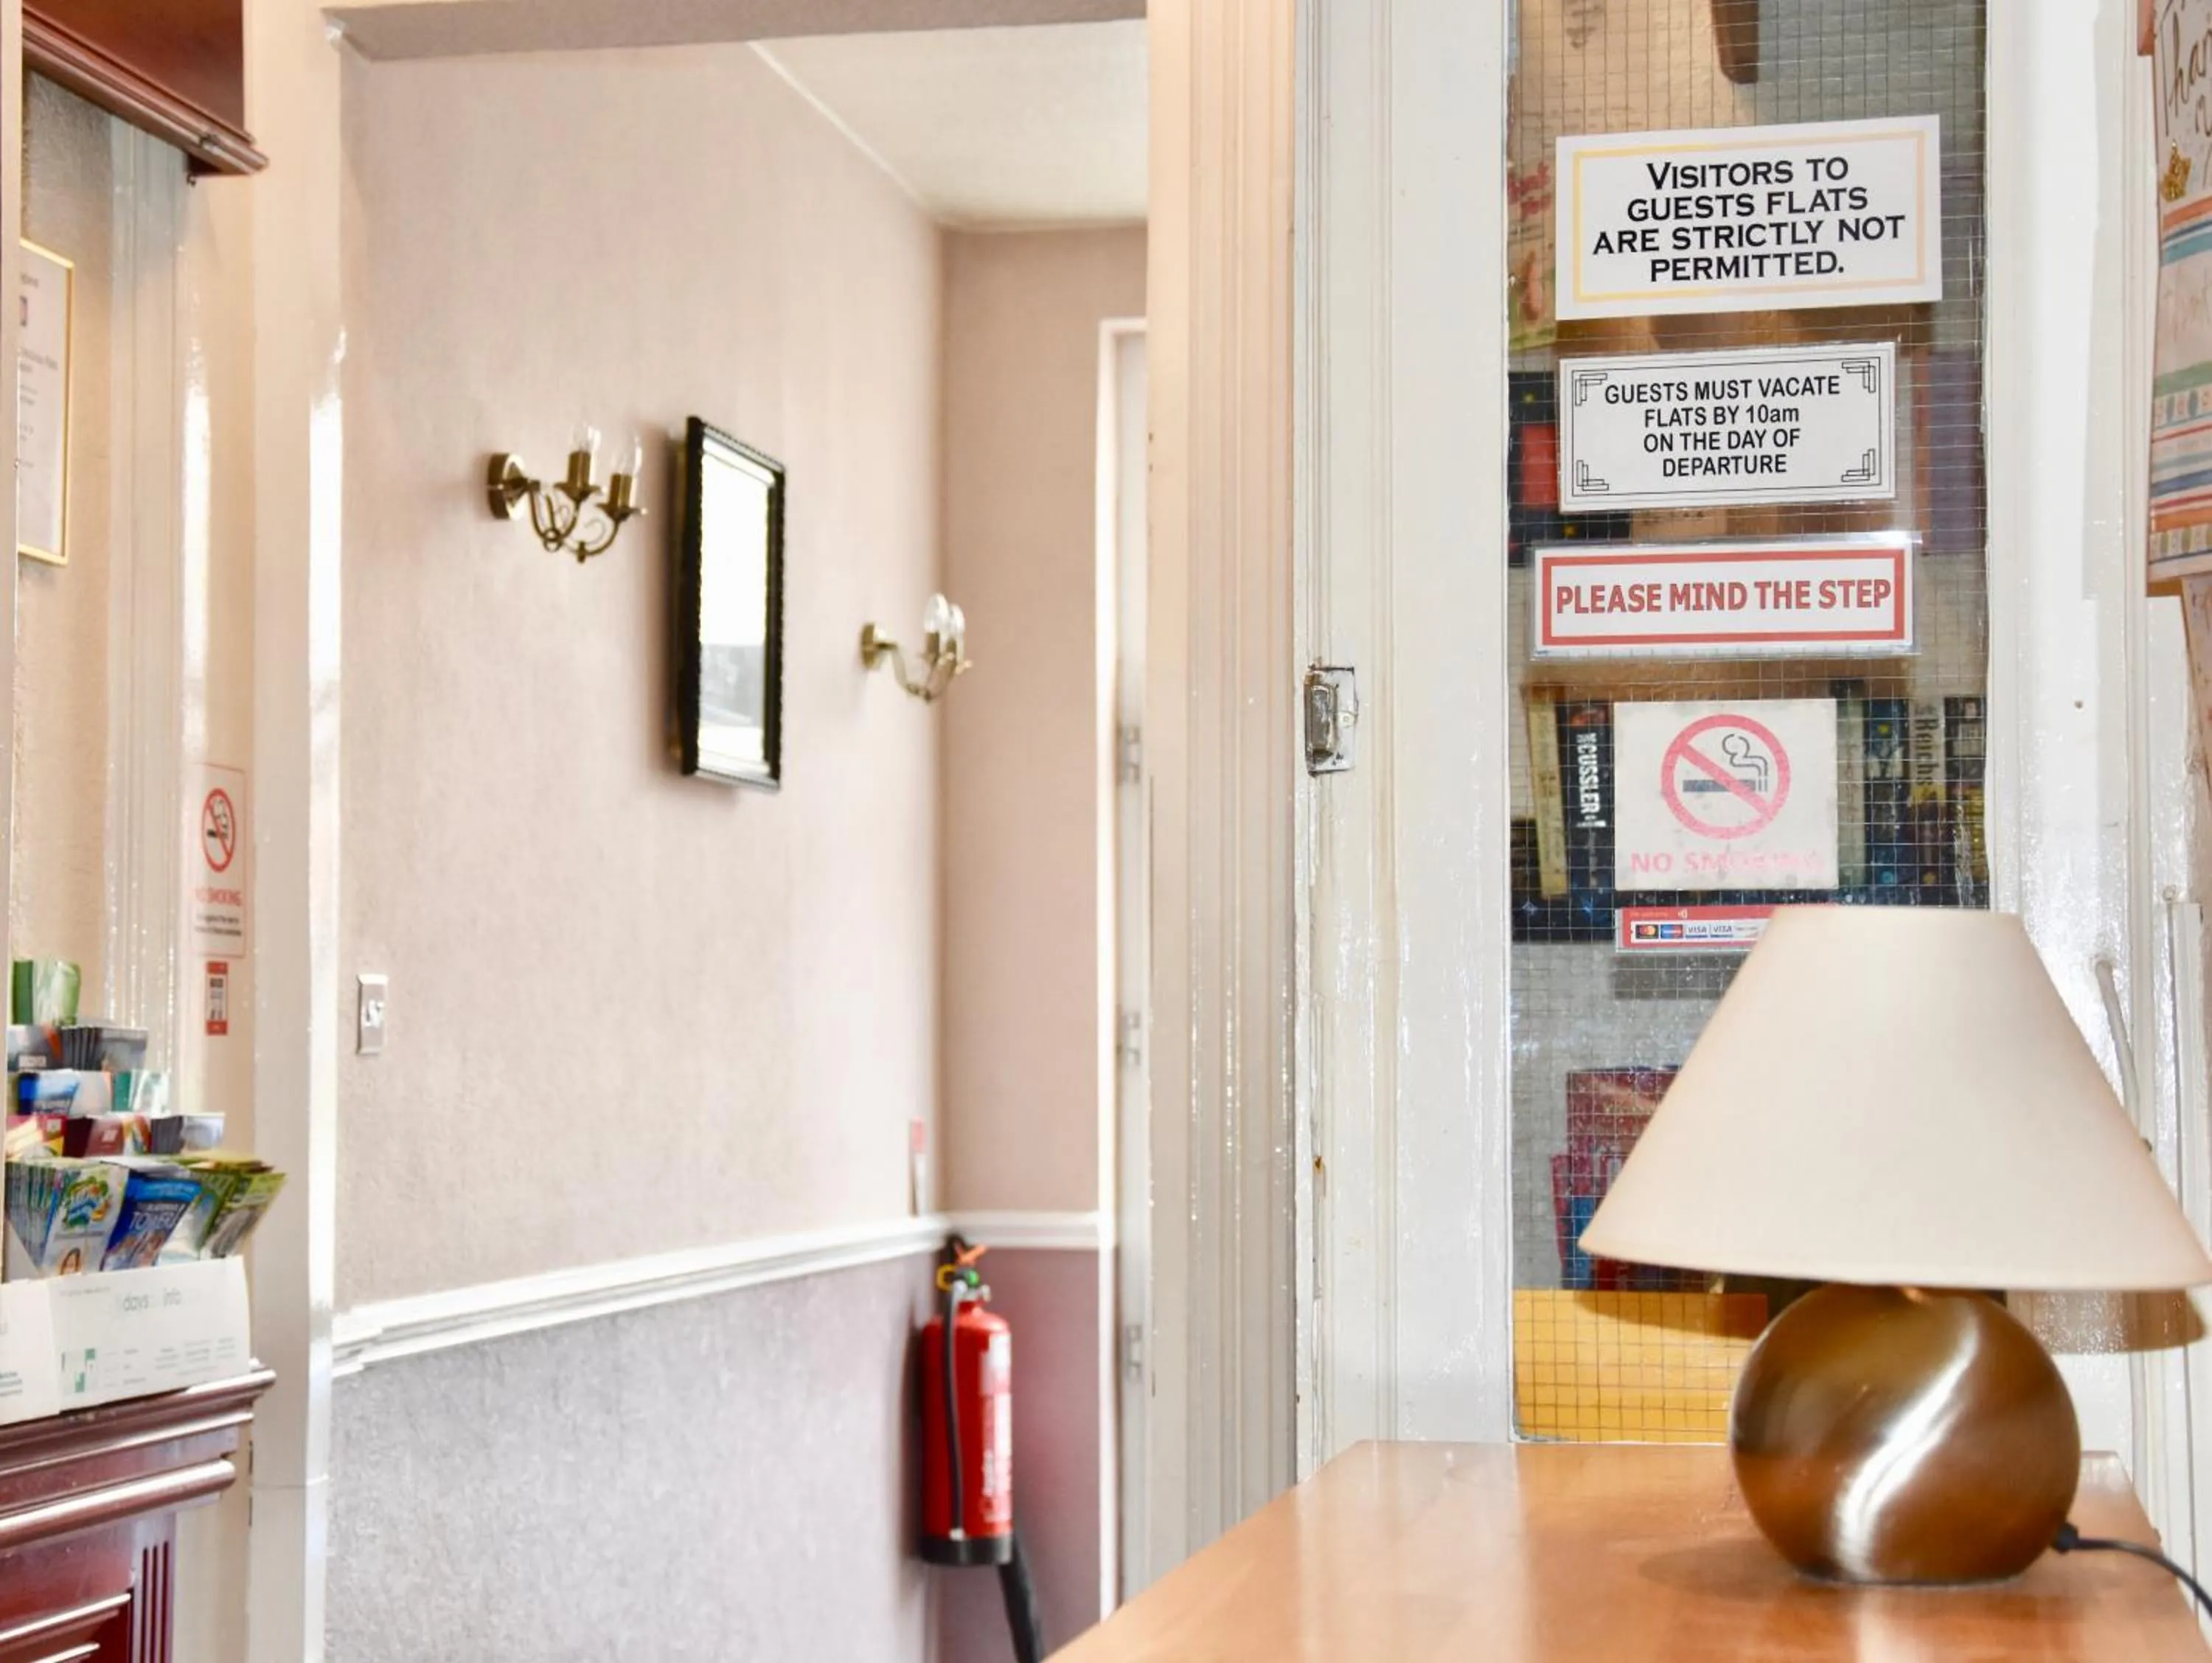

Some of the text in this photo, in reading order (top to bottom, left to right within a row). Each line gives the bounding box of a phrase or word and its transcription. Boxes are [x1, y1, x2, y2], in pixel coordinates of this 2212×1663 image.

[1646, 156, 1848, 190] VISITORS TO
[1627, 186, 1868, 223] GUESTS FLATS
[1593, 215, 1906, 255] ARE STRICTLY NOT
[1651, 251, 1844, 282] PERMITTED.
[1604, 375, 1840, 405] GUESTS MUST VACATE
[1645, 403, 1799, 428] FLATS BY 10am
[1644, 428, 1801, 453] ON THE DAY OF
[1663, 453, 1787, 477] DEPARTURE
[1557, 579, 1891, 614] PLEASE MIND THE STEP
[1576, 745, 1600, 814] CUSSLER
[1630, 851, 1674, 874] NO
